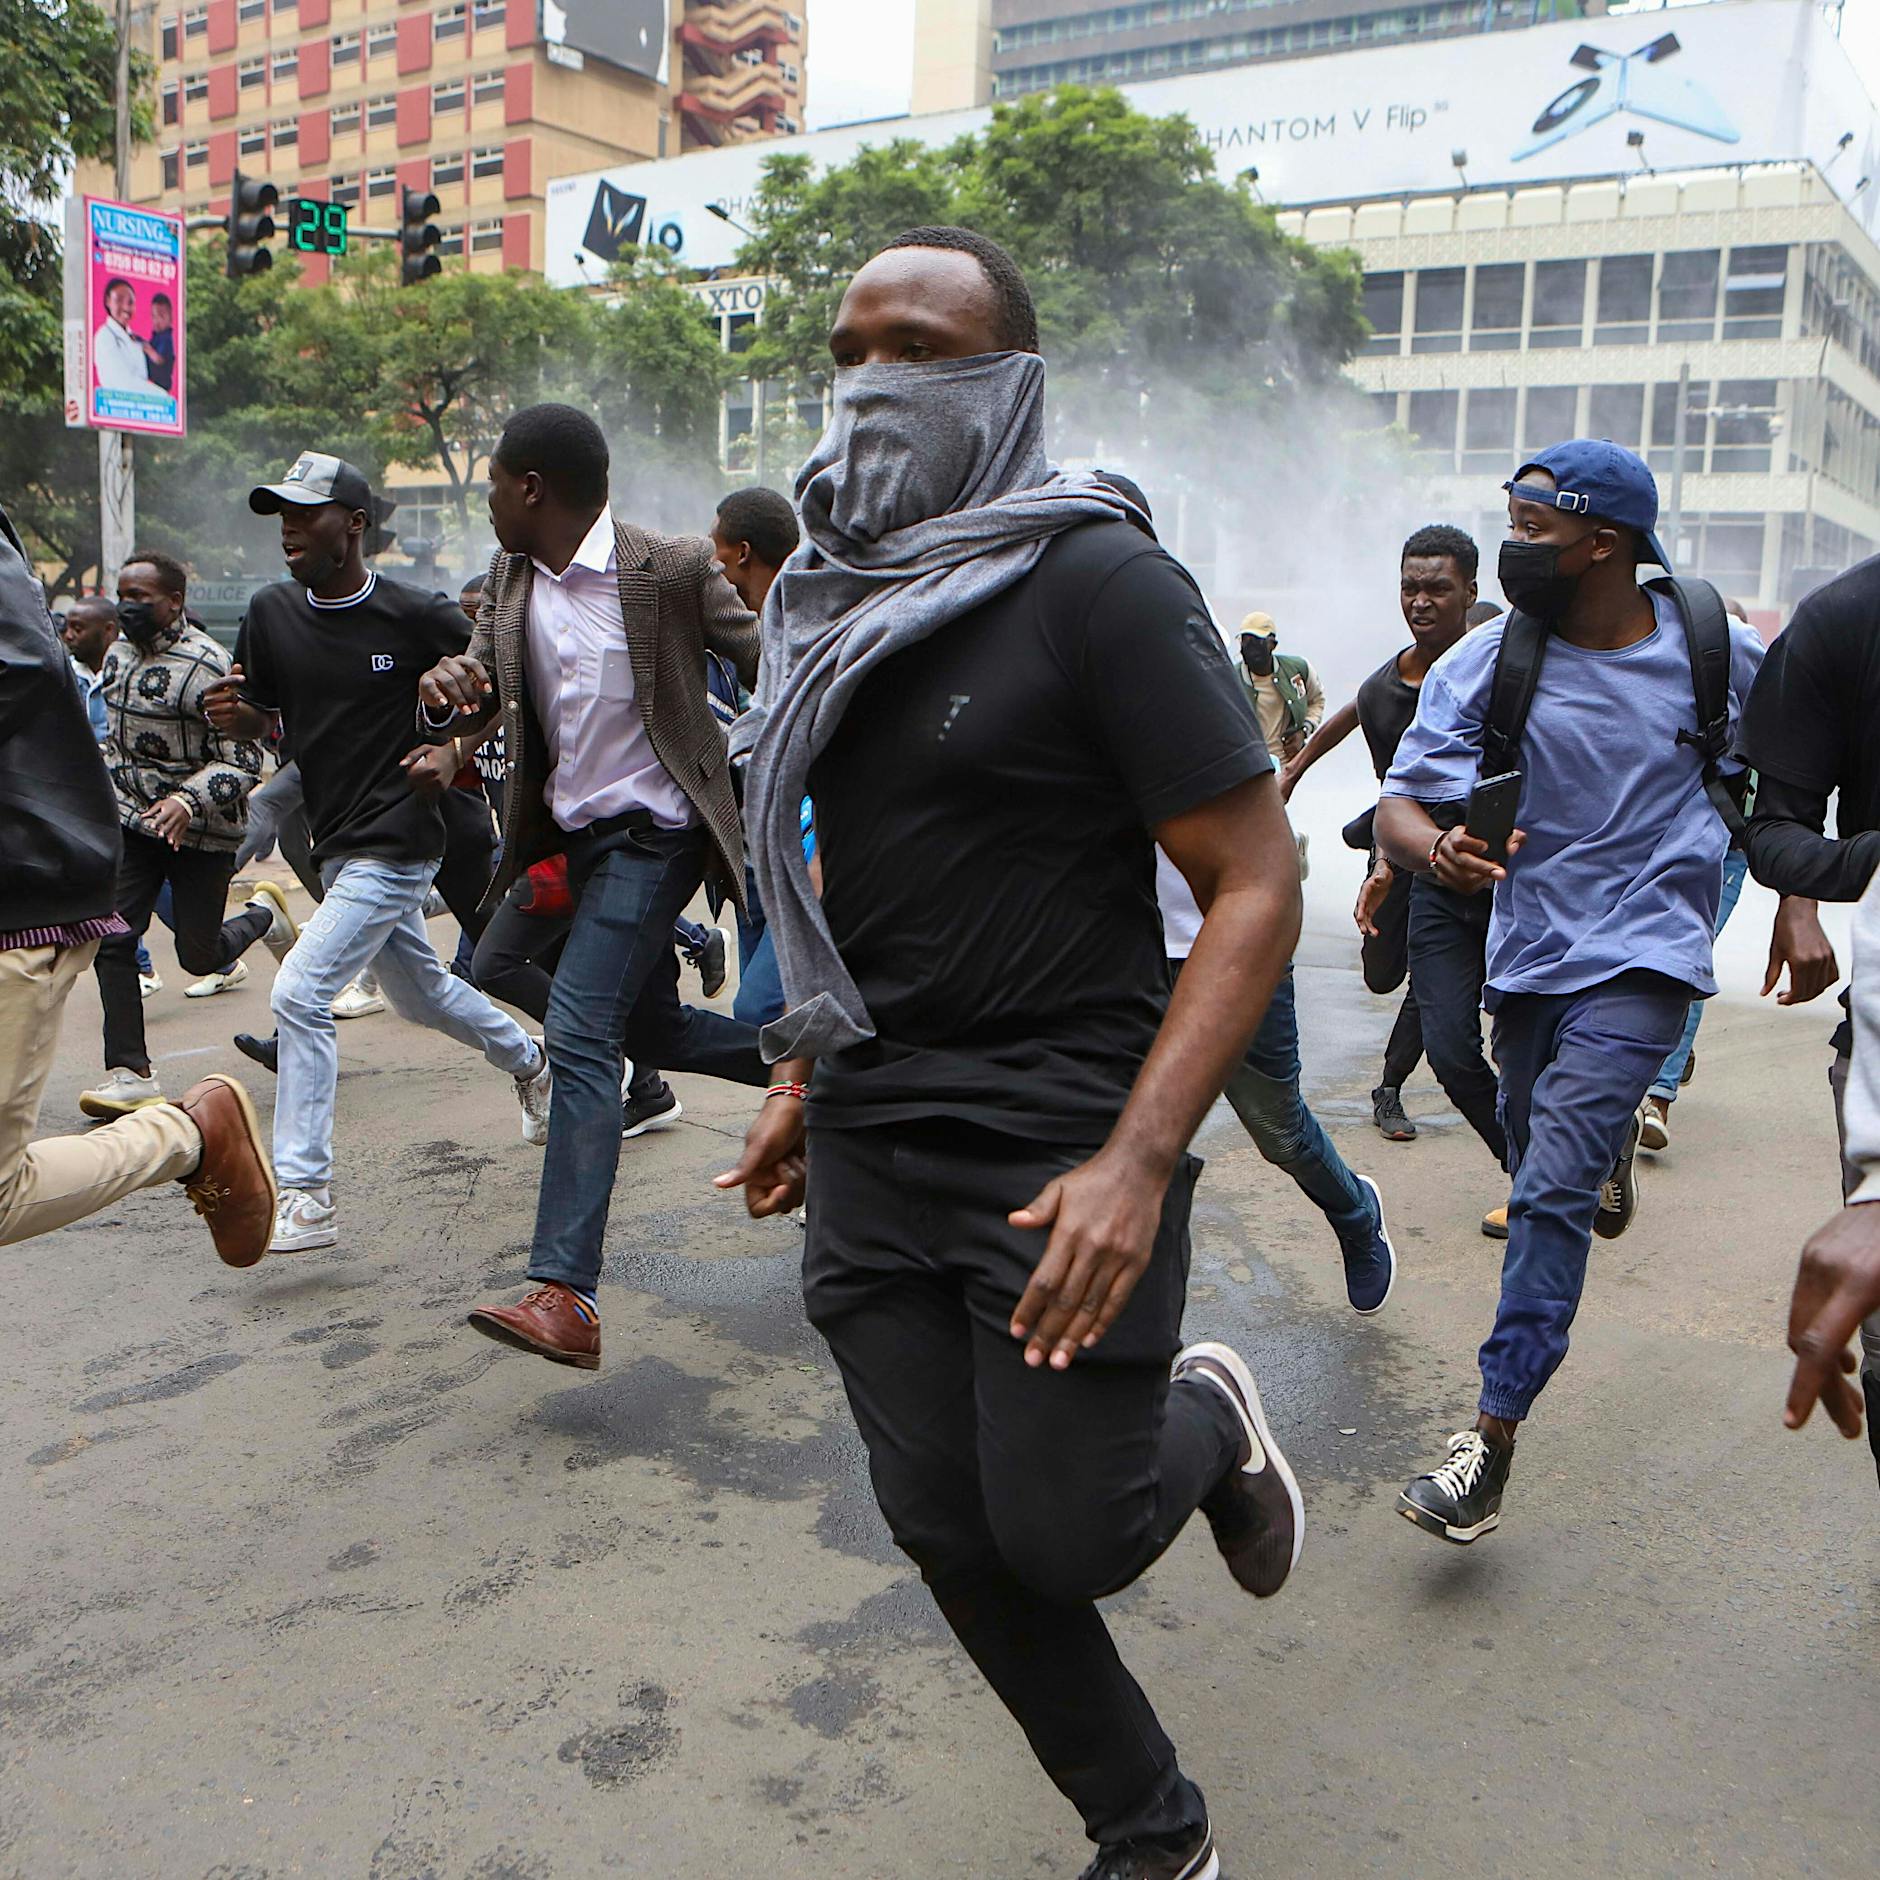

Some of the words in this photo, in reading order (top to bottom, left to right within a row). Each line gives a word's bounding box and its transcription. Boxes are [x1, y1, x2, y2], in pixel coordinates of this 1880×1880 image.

[1352, 107, 1371, 131] V
[1386, 104, 1428, 133] Flip
[295, 200, 347, 256] 29
[371, 654, 394, 672] DG
